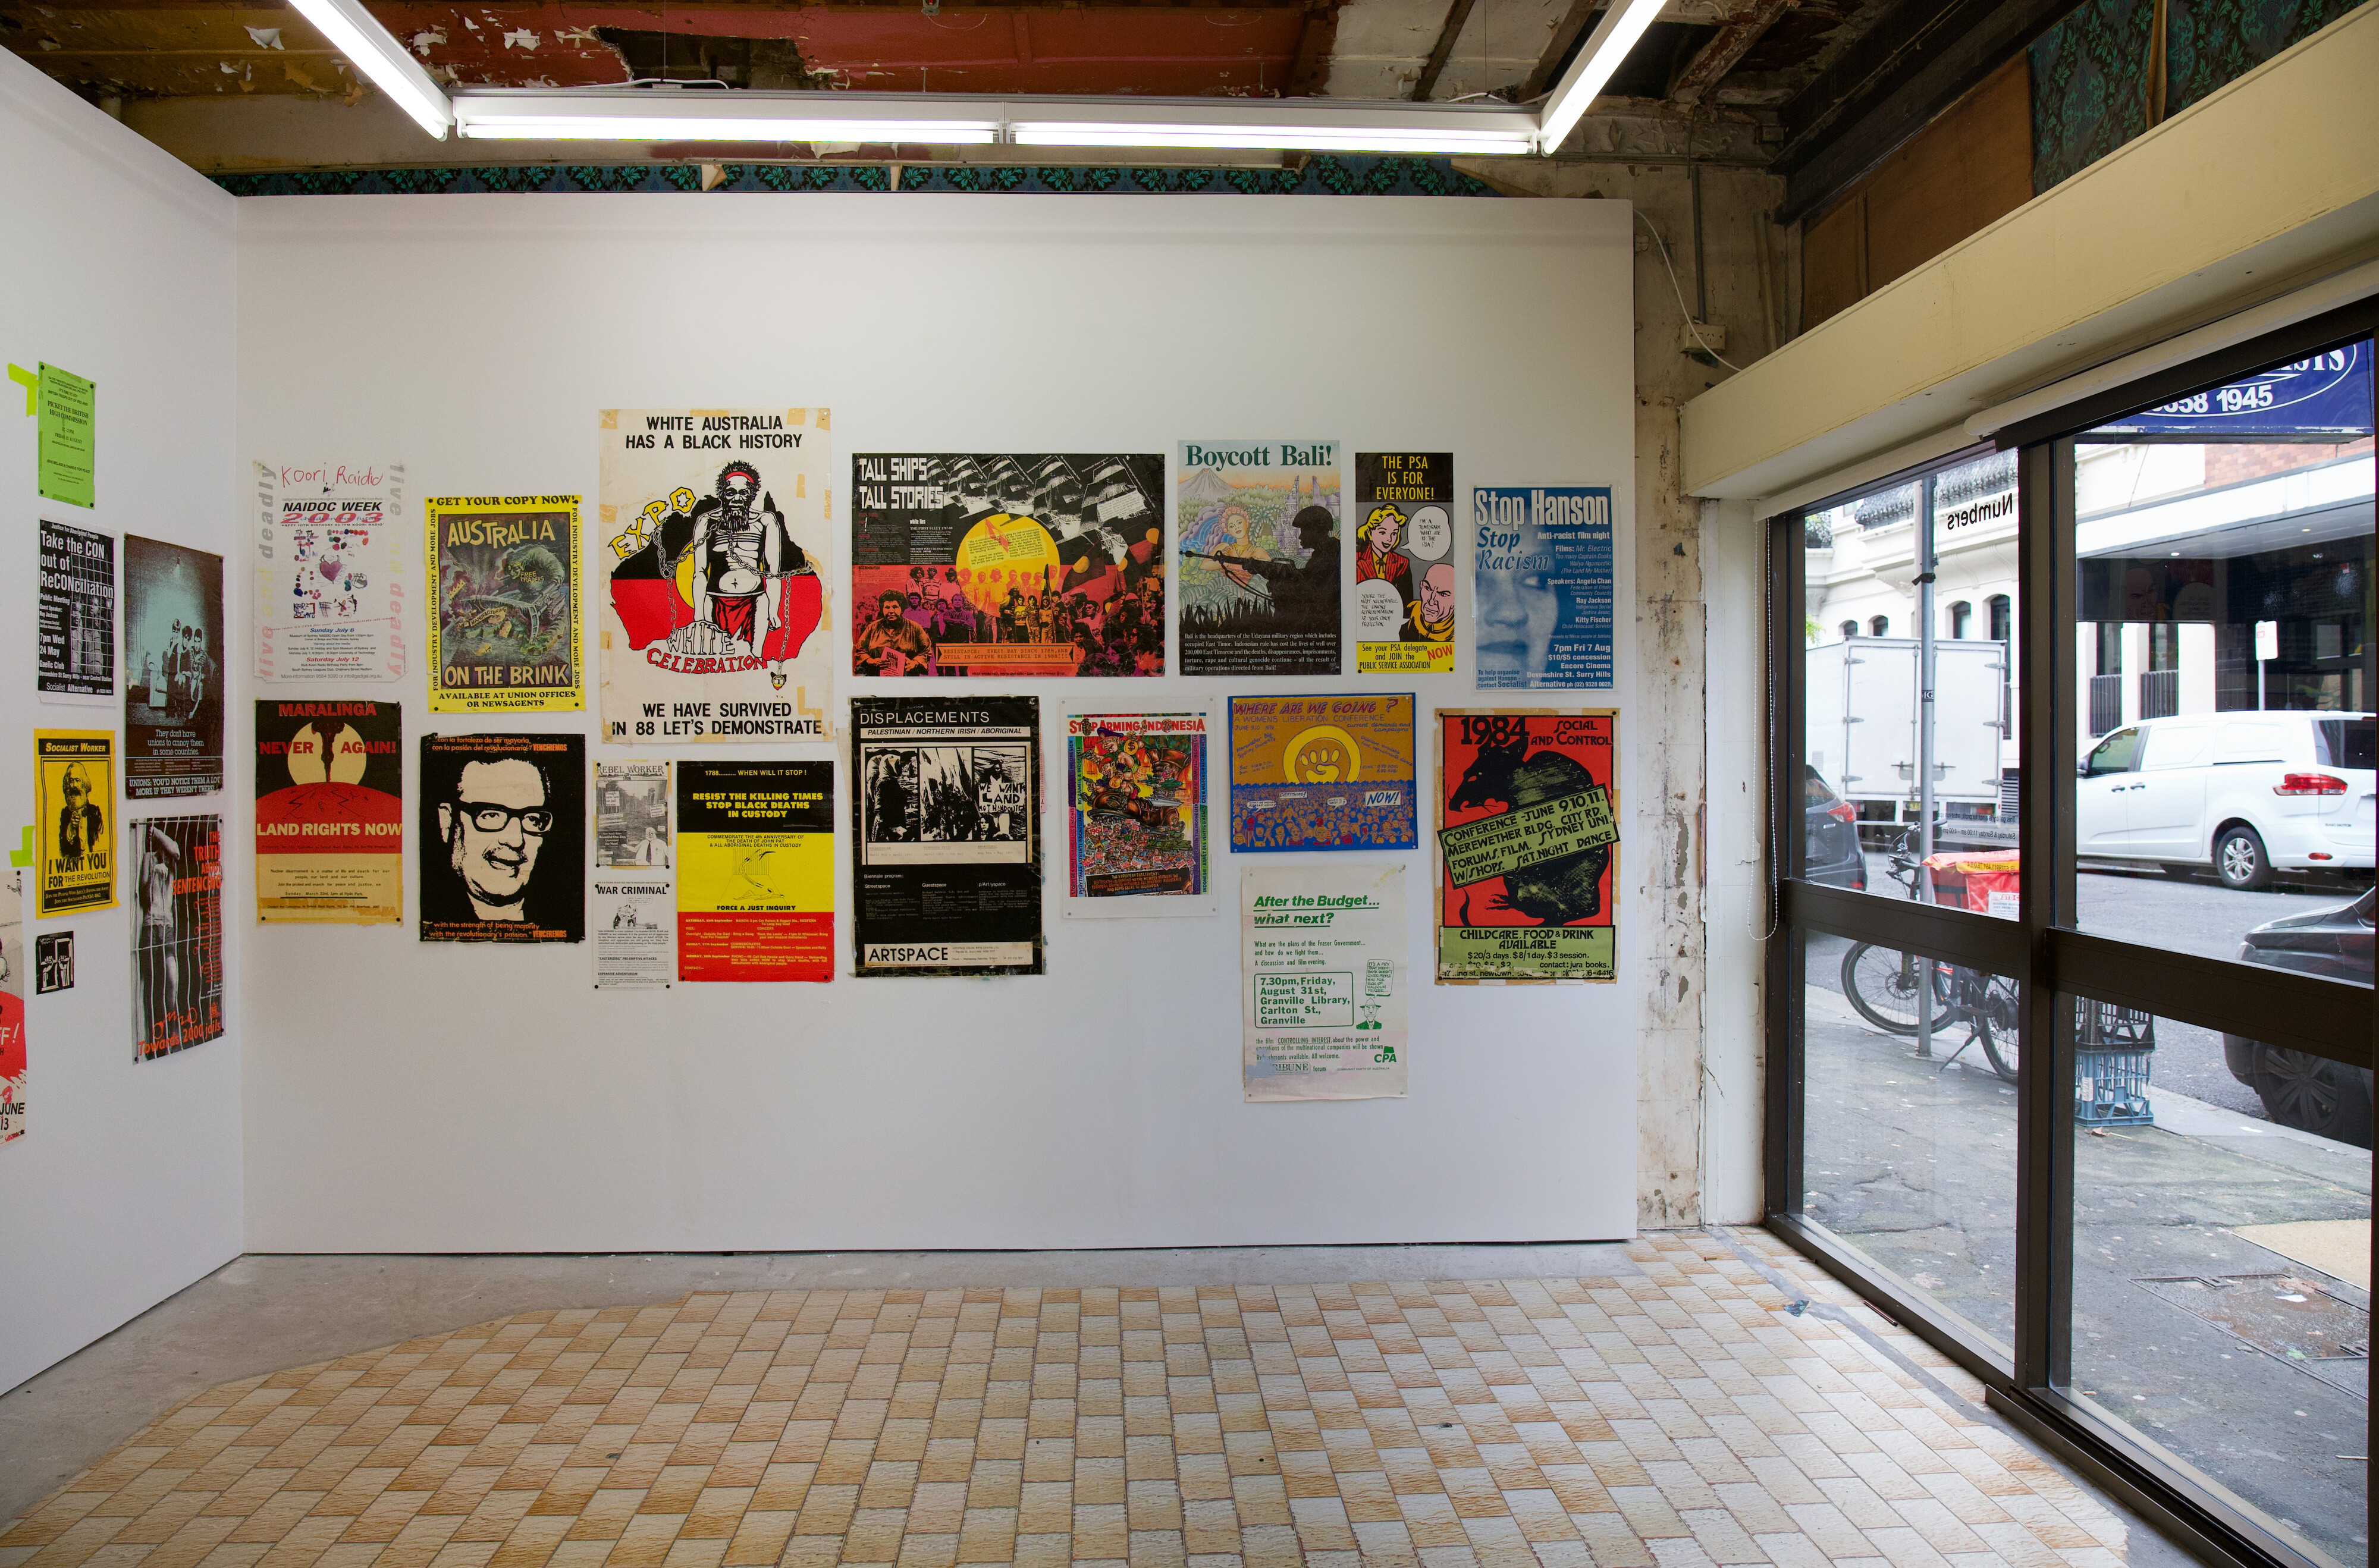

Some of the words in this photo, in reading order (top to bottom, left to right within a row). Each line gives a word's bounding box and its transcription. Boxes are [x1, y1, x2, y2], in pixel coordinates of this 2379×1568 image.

[2151, 392, 2208, 413] 58
[2217, 385, 2273, 411] 1945
[48, 401, 63, 411] PICKET
[73, 407, 88, 419] BRITISH
[50, 410, 60, 418] HIGH
[61, 413, 87, 426] COMMISSION
[647, 416, 693, 430] WHITE
[702, 416, 782, 430] AUSTRALIA
[626, 435, 655, 449] HAS
[664, 436, 674, 449] A
[683, 435, 731, 449] BLACK
[740, 435, 802, 449] HISTORY
[1186, 445, 1270, 471] Boycott
[1280, 445, 1331, 466] Bali!
[1382, 457, 1402, 469] THE
[1409, 457, 1428, 469] PSA
[281, 463, 326, 488] Koori
[859, 458, 887, 480] TALL
[891, 458, 927, 480] SHIPS
[1388, 472, 1396, 484] IS
[1403, 472, 1423, 484] FOR
[859, 487, 887, 509] TALL
[891, 486, 944, 509] STORIES
[1376, 487, 1434, 500] EVERYONE!
[283, 502, 337, 511] NAIDOC
[341, 502, 382, 511] WEEK
[437, 497, 463, 505] GET
[466, 497, 501, 505] YOUR
[504, 497, 537, 505] COPY
[1476, 490, 1525, 531] Stop
[1531, 490, 1608, 525] Hanson
[280, 513, 383, 523] 2003
[608, 486, 696, 560] EXPO
[447, 520, 555, 548] AUSTRALIA
[1477, 527, 1520, 553] Stop
[41, 530, 64, 549] Take
[67, 540, 82, 554] the
[86, 541, 105, 559] CON
[41, 554, 57, 569] out
[60, 556, 70, 571] of
[1479, 549, 1549, 570] Racism
[41, 571, 114, 598] ReCONciliation
[40, 633, 51, 643] 7pm
[52, 634, 65, 644] Wed
[40, 646, 46, 655] 24
[47, 647, 60, 657] May
[1427, 645, 1452, 661] NOW
[1595, 644, 1610, 652] Aug
[647, 648, 768, 674] CELEBRATION
[444, 666, 469, 686] ON
[475, 666, 503, 685] THE
[510, 664, 568, 686] BRINK
[279, 703, 376, 717] MARALINGA
[1234, 702, 1278, 714] WHERE
[1280, 702, 1303, 714] ARE
[1307, 702, 1327, 714] WE
[1332, 701, 1377, 713] GOING
[860, 712, 989, 724] DISPLACEMENTS
[611, 722, 626, 736] IN
[636, 721, 655, 735] 88
[663, 721, 704, 735] LET'S
[712, 719, 821, 734] DEMONSTRATE
[1100, 721, 1140, 731] ARMING
[1461, 717, 1530, 745] 1984
[1553, 721, 1597, 734] SOCIAL
[156, 730, 169, 738] They
[1531, 736, 1553, 746] AND
[1556, 731, 1612, 746] CONTROL
[46, 743, 78, 752] SOCIALIST
[81, 743, 105, 752] WORKER
[259, 741, 313, 754] NEVER
[341, 741, 396, 753] AGAIN!
[627, 765, 664, 774] WORKER
[982, 794, 1021, 803] LAND
[1367, 793, 1400, 806] NOW!
[257, 824, 299, 835] LAND
[302, 823, 360, 835] RIGHTS
[365, 823, 402, 835] NOW
[209, 831, 221, 843] THE
[194, 846, 221, 862] TRUTH
[49, 859, 52, 874] I
[55, 856, 84, 873] WANT
[87, 853, 106, 869] YOU
[202, 861, 221, 873] ABOUT
[49, 876, 63, 888] FOR
[77, 871, 110, 881] REVOLUTION
[172, 877, 221, 895] SENTENCING
[597, 886, 618, 894] WAR
[621, 885, 666, 894] CRIMINAL
[1254, 896, 1289, 907] After
[1292, 896, 1314, 906] the
[1317, 895, 1380, 908] Budget...
[1254, 914, 1289, 925] what
[1294, 913, 1334, 923] next?
[1460, 930, 1521, 939] CHILDCARE,
[1523, 930, 1553, 939] FOOD
[1562, 930, 1593, 939] DRINK
[1499, 940, 1556, 949] AVAILABLE
[869, 947, 947, 961] ARTSPACE
[1311, 996, 1350, 1005] Library,
[139, 1035, 179, 1056] Towards
[183, 1025, 203, 1043] 2000
[205, 1020, 221, 1039] jails
[1374, 1054, 1396, 1063] CPA
[0, 1102, 25, 1115] JUNE
